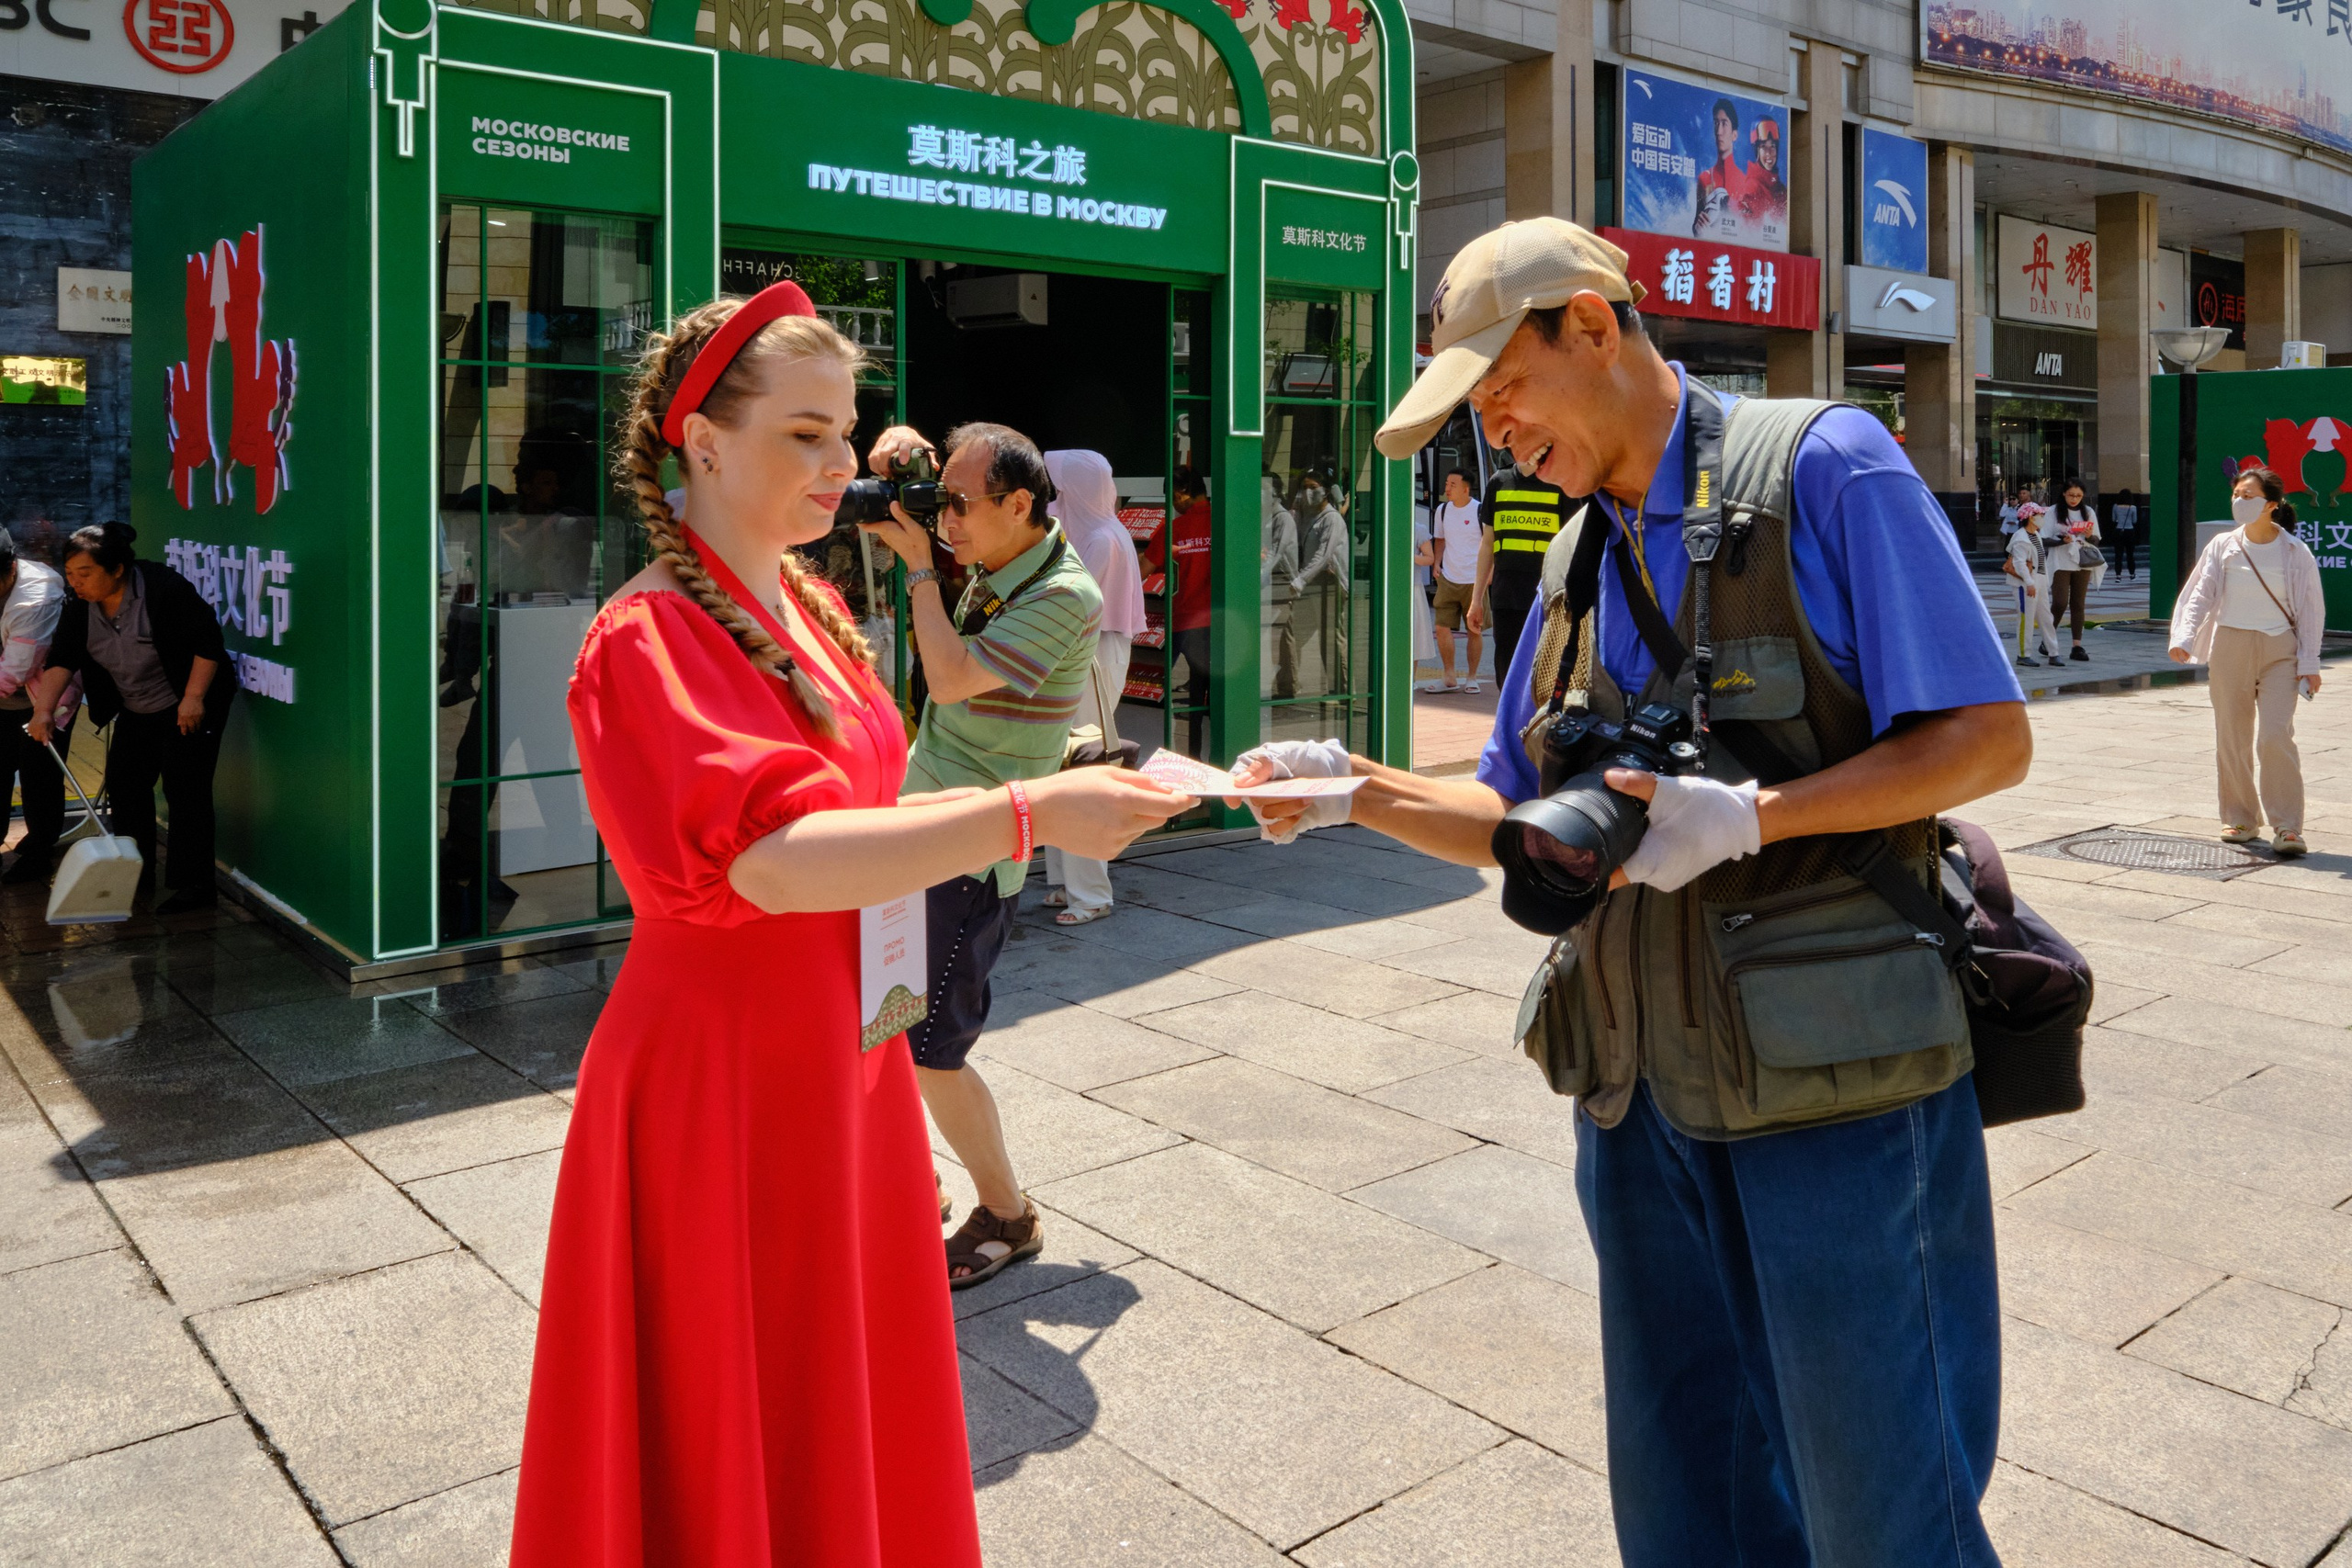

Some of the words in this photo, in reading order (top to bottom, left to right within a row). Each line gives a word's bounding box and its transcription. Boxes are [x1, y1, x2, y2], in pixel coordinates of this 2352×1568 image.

[472, 116, 630, 152] МОСКОВСКИЕ
[1632, 122, 1671, 150] 爱运动
[472, 137, 571, 164] СЕЗОНЫ
[907, 124, 1088, 186] 莫斯科之旅
[1632, 147, 1696, 178] 中国有安踏
[808, 163, 1030, 214] ПУТЕШЕСТВИЕ
[1032, 192, 1053, 217] В
[1057, 195, 1167, 231] МОСКВУ
[1872, 203, 1900, 227] ANTA
[1282, 225, 1367, 253] 莫斯科文化节
[1660, 248, 1776, 313] 稻香村
[2022, 232, 2094, 304] 丹耀
[2030, 297, 2057, 316] DAN
[2065, 302, 2091, 321] YAO
[2035, 352, 2063, 377] ANTA
[1696, 470, 1710, 508] Nikon
[1629, 723, 1657, 739] Nikon
